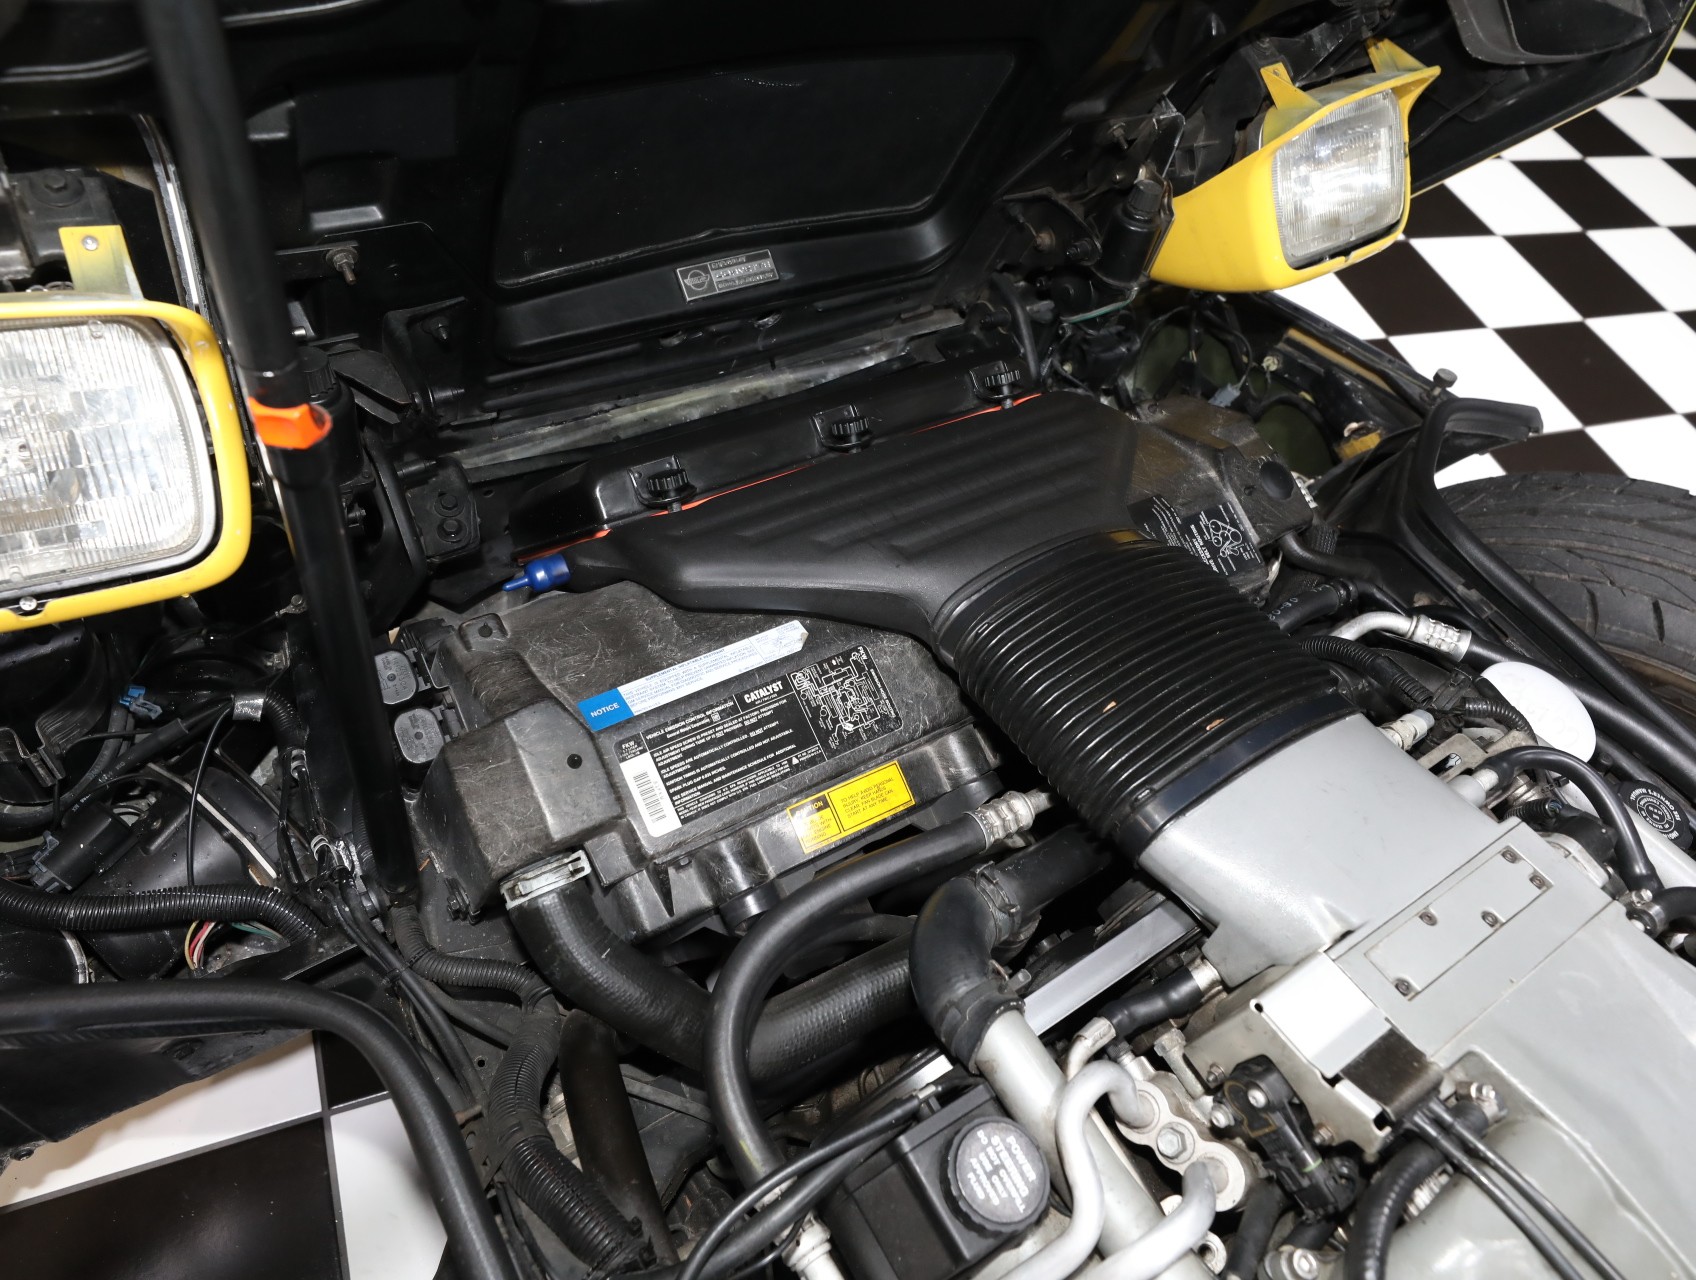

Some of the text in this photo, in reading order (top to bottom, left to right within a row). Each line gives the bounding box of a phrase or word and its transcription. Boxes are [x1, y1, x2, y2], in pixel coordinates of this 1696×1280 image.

[742, 679, 785, 704] CATALYST
[589, 700, 620, 718] NOTICE
[663, 720, 686, 733] EMISSION
[684, 711, 706, 724] CONTROL
[704, 700, 734, 716] INFORMATION
[620, 739, 636, 750] FKW
[652, 749, 663, 757] IDLE
[661, 746, 670, 754] AIR
[668, 741, 683, 751] SPEED
[681, 735, 697, 745] SCREW
[699, 727, 716, 738] PRESET
[714, 724, 724, 732] AND
[679, 741, 696, 752] DURING
[694, 737, 706, 746] TUNE
[756, 709, 774, 720] ATTEMPT
[659, 766, 670, 774] IDLE
[668, 759, 686, 770] SPEEDS
[684, 756, 694, 764] ARE
[679, 786, 698, 797] SERVICE
[765, 752, 775, 760] FOR
[668, 783, 683, 794] SPARK
[681, 779, 694, 788] PLUG
[692, 775, 702, 783] GAP
[840, 776, 894, 804] TO HELP AVOID PERSONAL
[859, 791, 872, 801] KEEP
[871, 785, 887, 795] HANDS
[860, 798, 871, 806] FAN
[870, 792, 884, 802] BLADE
[883, 787, 894, 796] CAN
[1647, 788, 1674, 809] OWNER'S
[846, 808, 862, 819] START
[867, 801, 877, 809] ANY
[1672, 810, 1681, 821] SEE
[975, 1128, 1028, 1214] DO NOT OVERFILL
[988, 1133, 1031, 1198] STEERING
[1004, 1133, 1038, 1183] POWER
[964, 1170, 987, 1201] FLUID
[967, 1155, 1002, 1207] APPROVED
[976, 1150, 1009, 1200] USE ONLY
